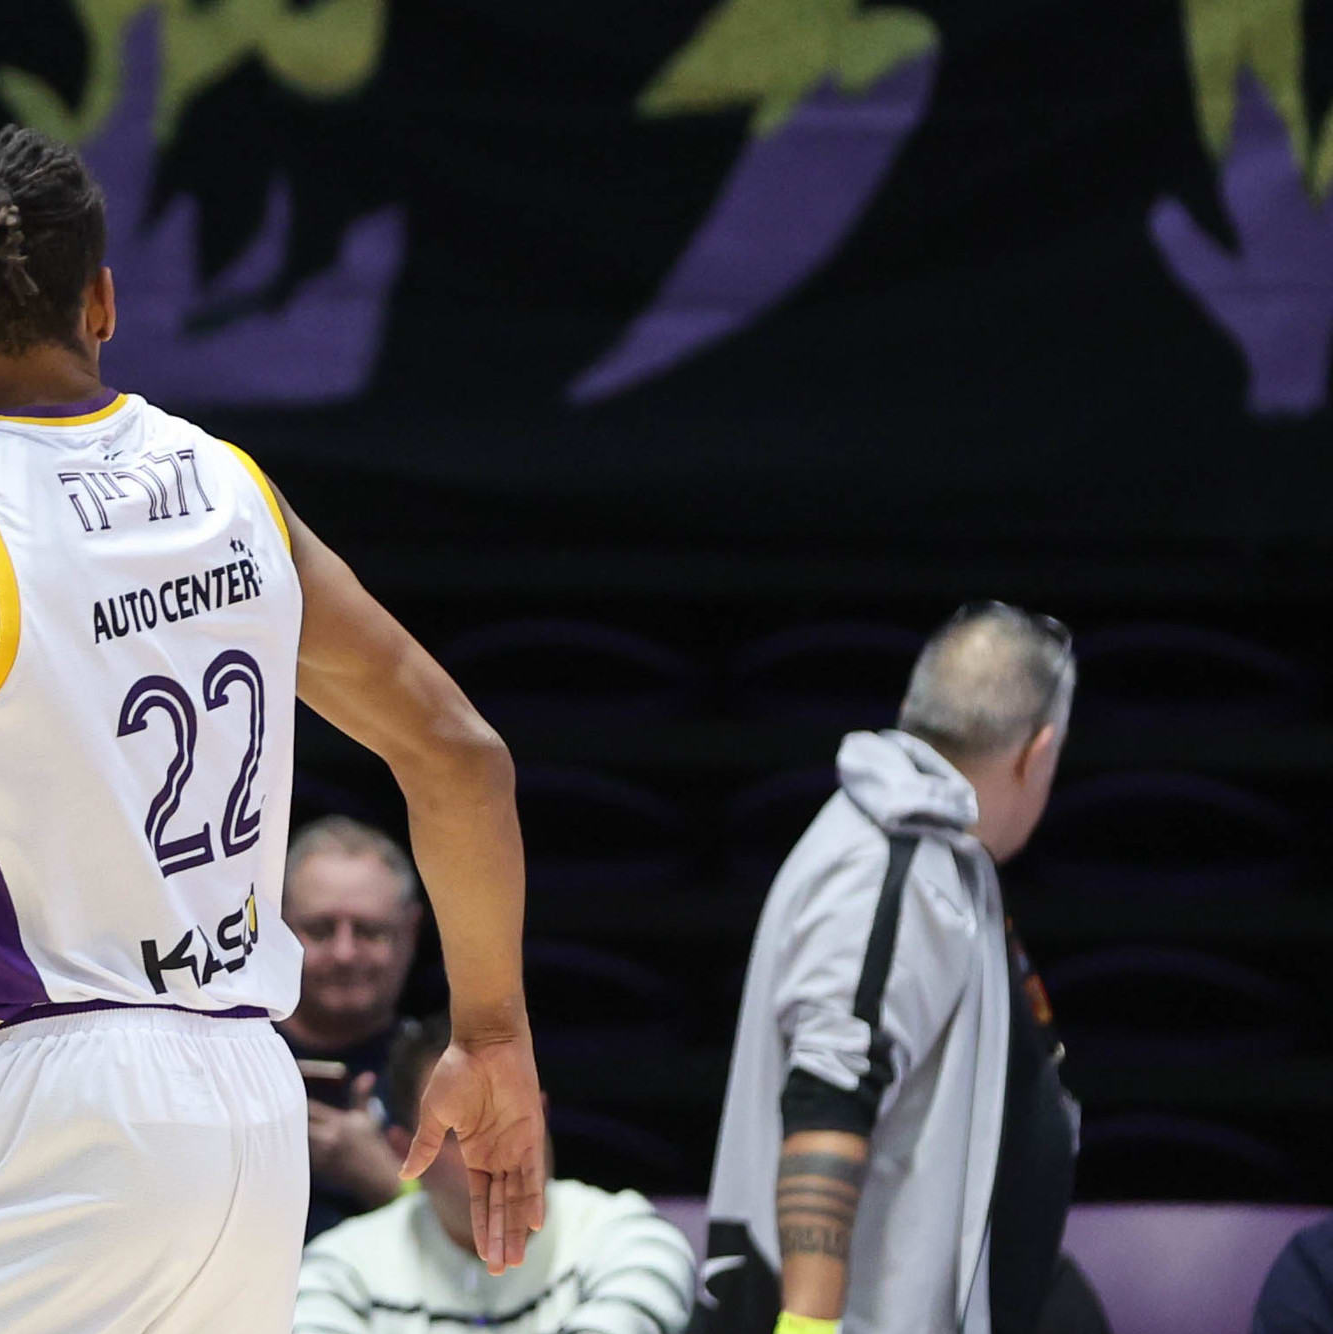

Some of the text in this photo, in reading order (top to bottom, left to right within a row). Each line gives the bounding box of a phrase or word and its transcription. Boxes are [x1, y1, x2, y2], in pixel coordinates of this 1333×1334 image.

[93, 558, 261, 644] AUTO CENTER
[117, 649, 266, 879] 22
